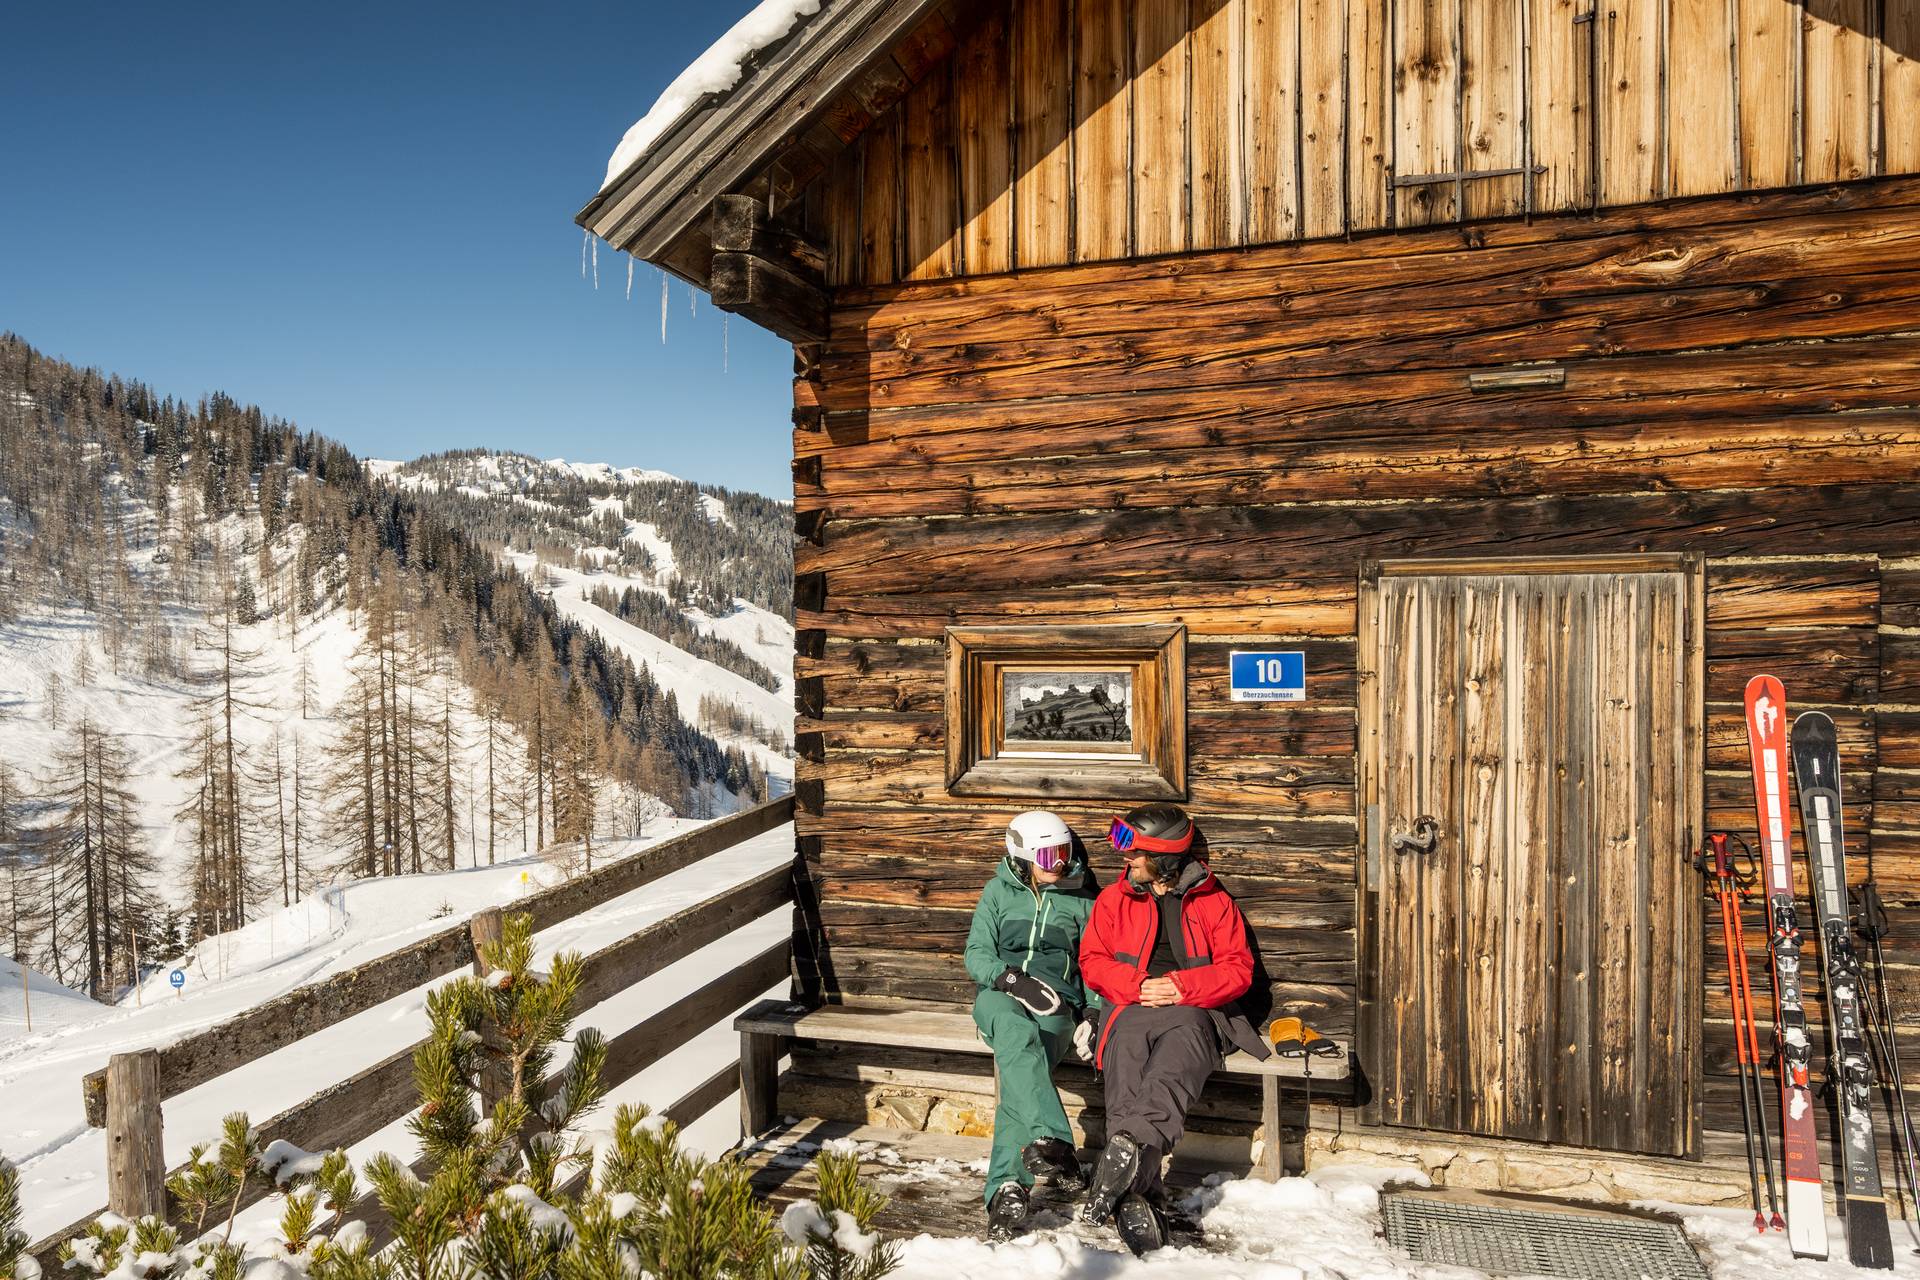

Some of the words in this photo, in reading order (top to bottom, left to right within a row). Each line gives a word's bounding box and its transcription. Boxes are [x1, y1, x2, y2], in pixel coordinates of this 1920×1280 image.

[1256, 659, 1282, 683] 10
[1242, 691, 1294, 699] Oberzauchensee
[171, 973, 182, 981] 10
